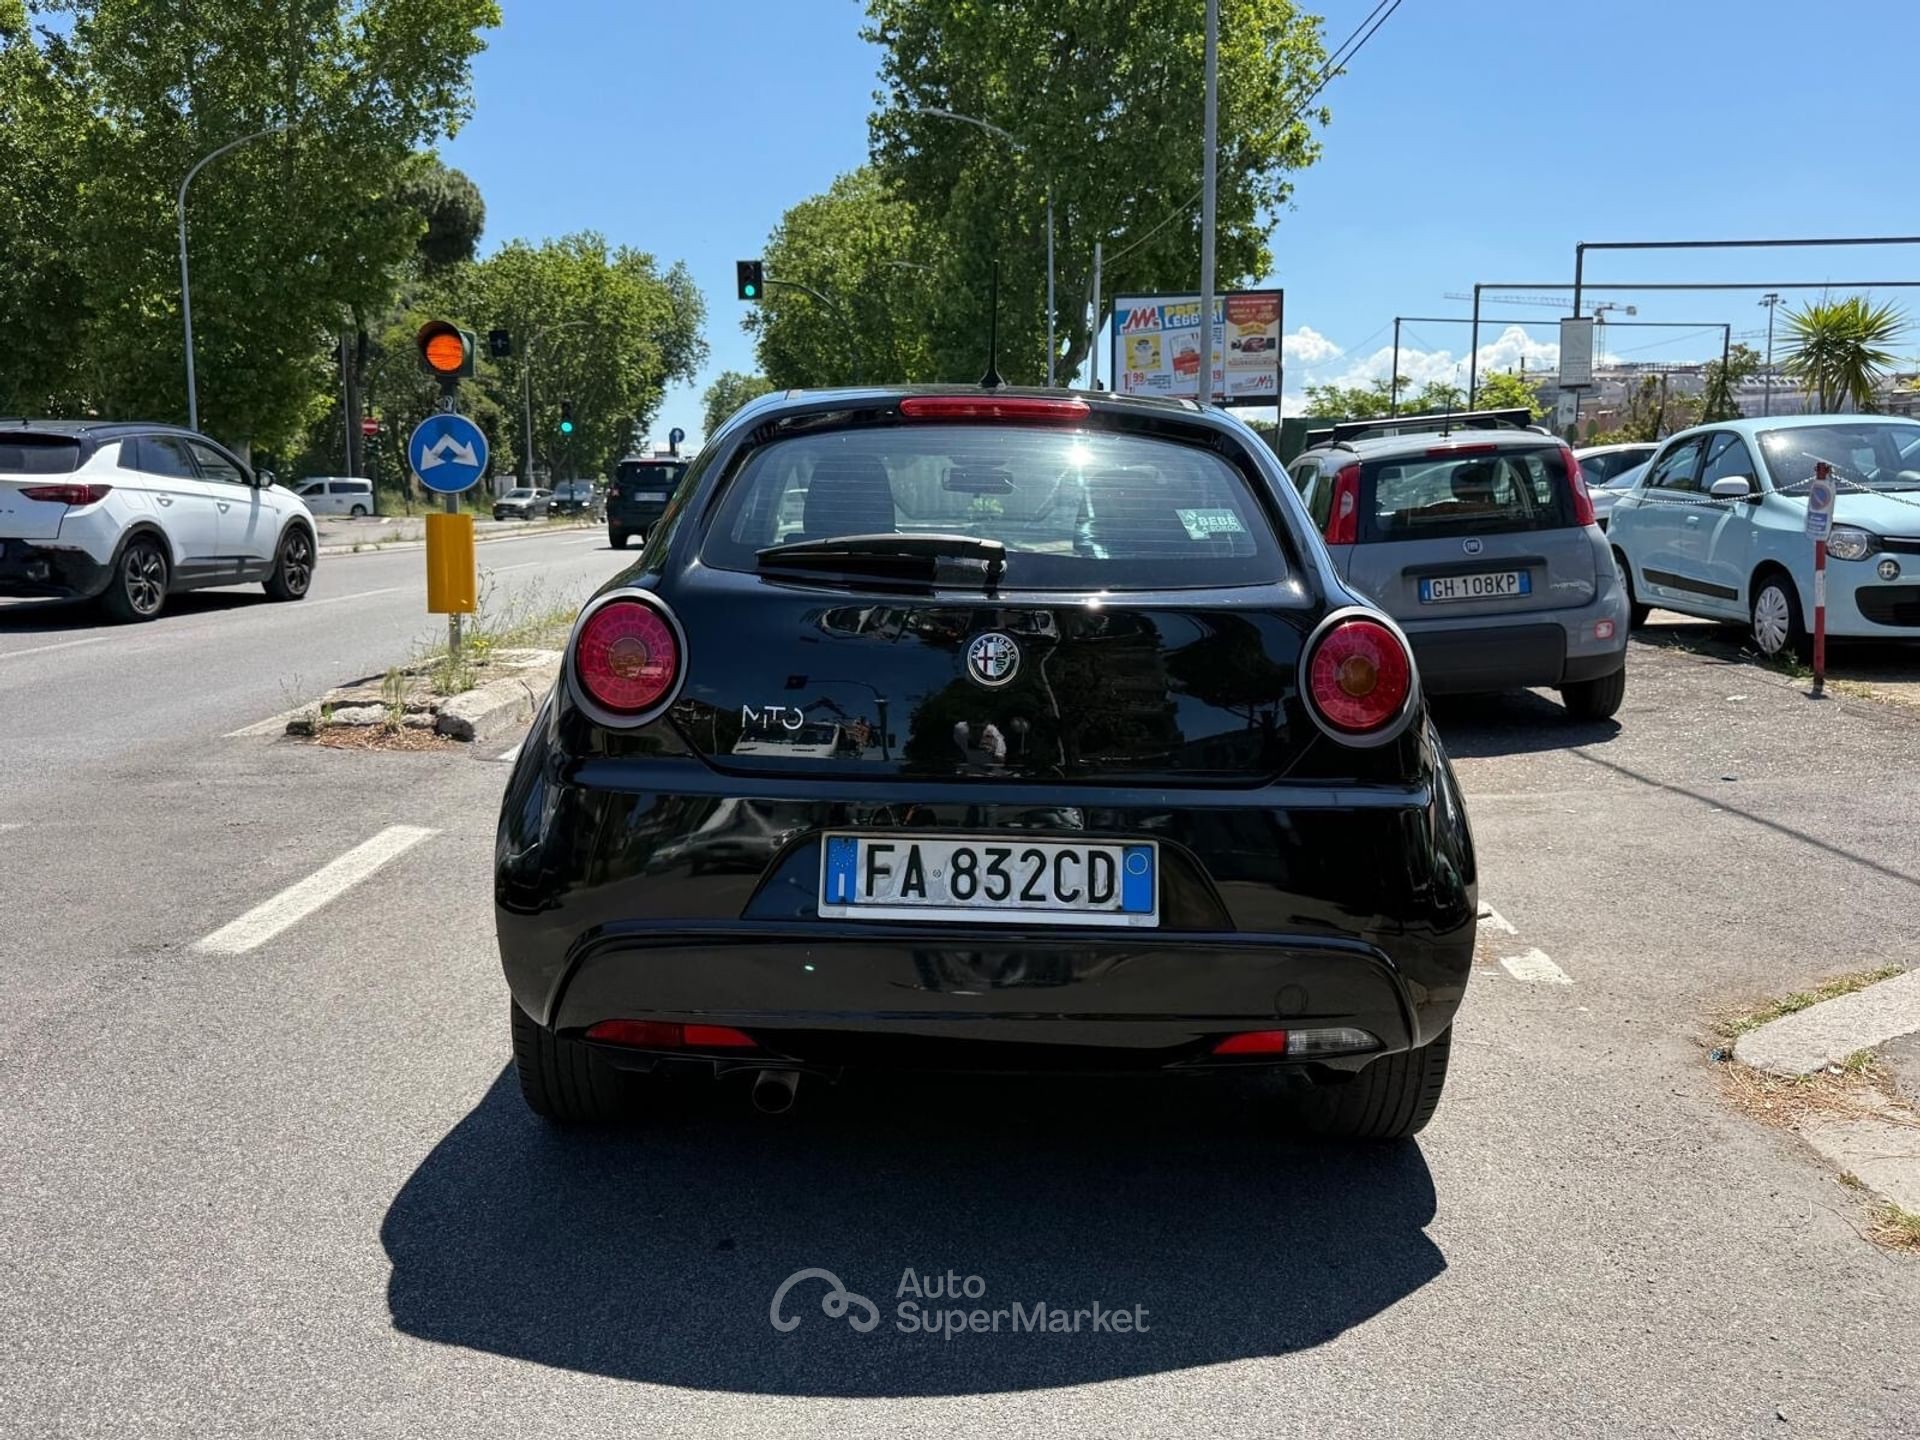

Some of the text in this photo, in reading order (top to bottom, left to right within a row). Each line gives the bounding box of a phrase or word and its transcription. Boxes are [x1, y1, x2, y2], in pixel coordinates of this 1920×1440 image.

[1432, 574, 1517, 598] GH 108KP
[865, 844, 1116, 905] FA 832CD
